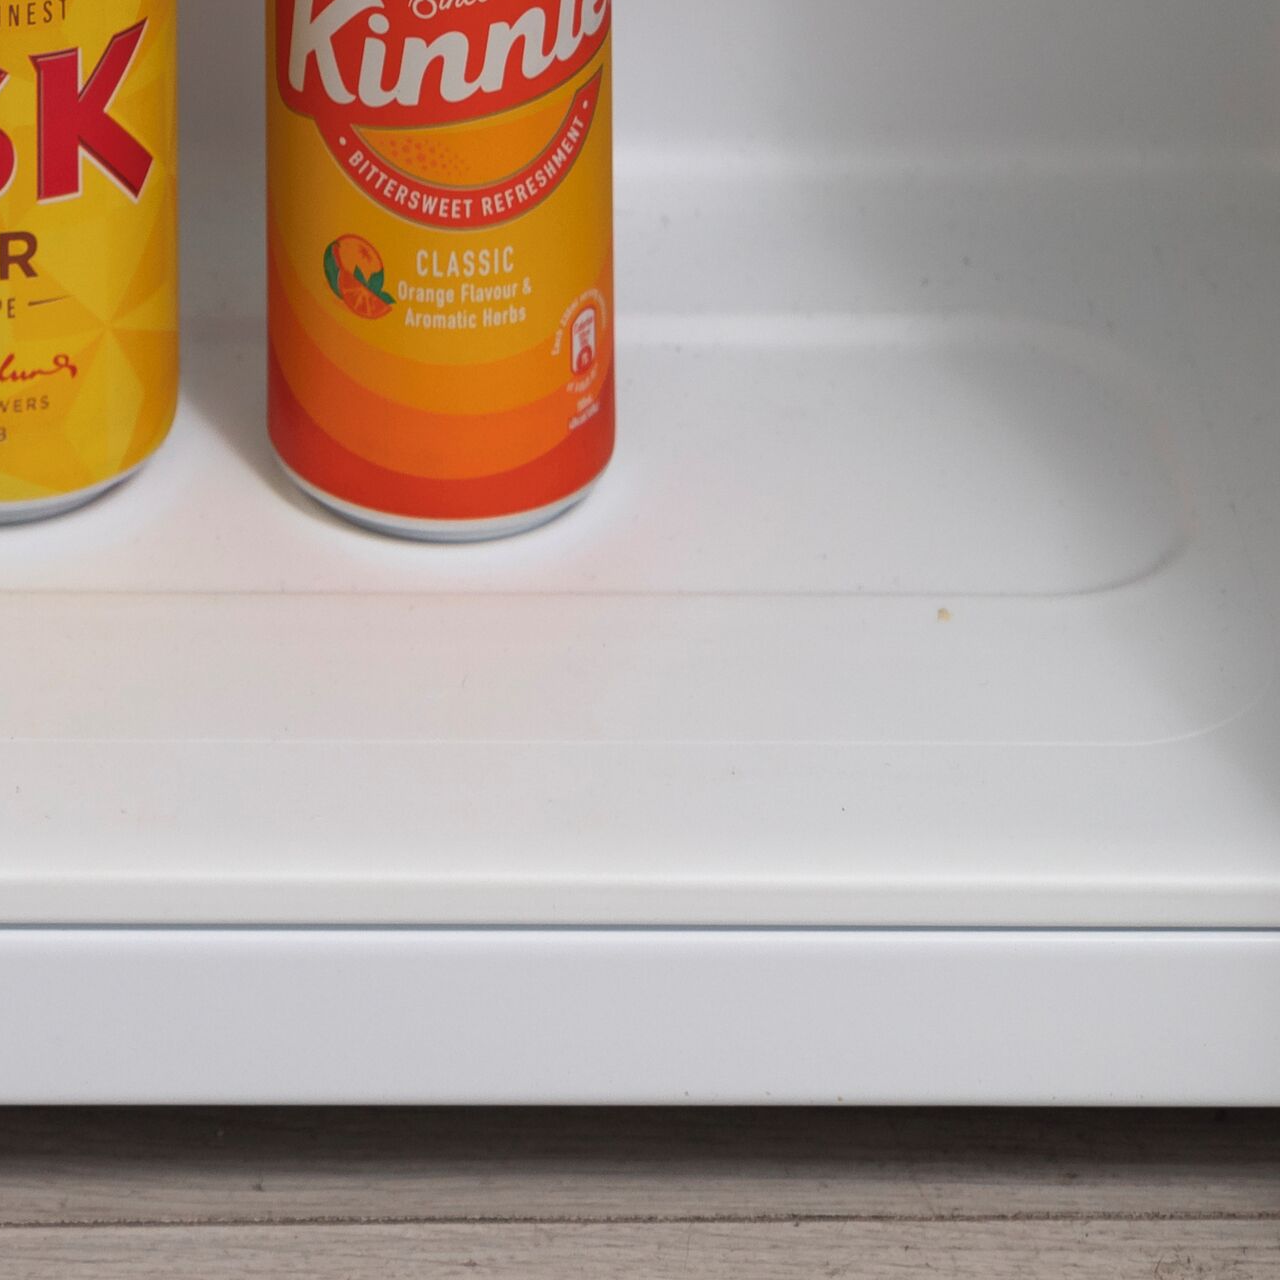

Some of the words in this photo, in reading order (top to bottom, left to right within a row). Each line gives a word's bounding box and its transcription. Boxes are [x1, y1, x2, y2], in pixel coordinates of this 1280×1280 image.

[348, 150, 472, 219] BITTERSWEET
[482, 115, 584, 216] REFRESHMENT
[416, 245, 514, 278] CLASSIC
[398, 280, 454, 308] Orange
[461, 282, 518, 304] Flavour
[522, 276, 532, 296] &
[405, 307, 477, 330] Aromatic
[483, 305, 526, 327] Herbs
